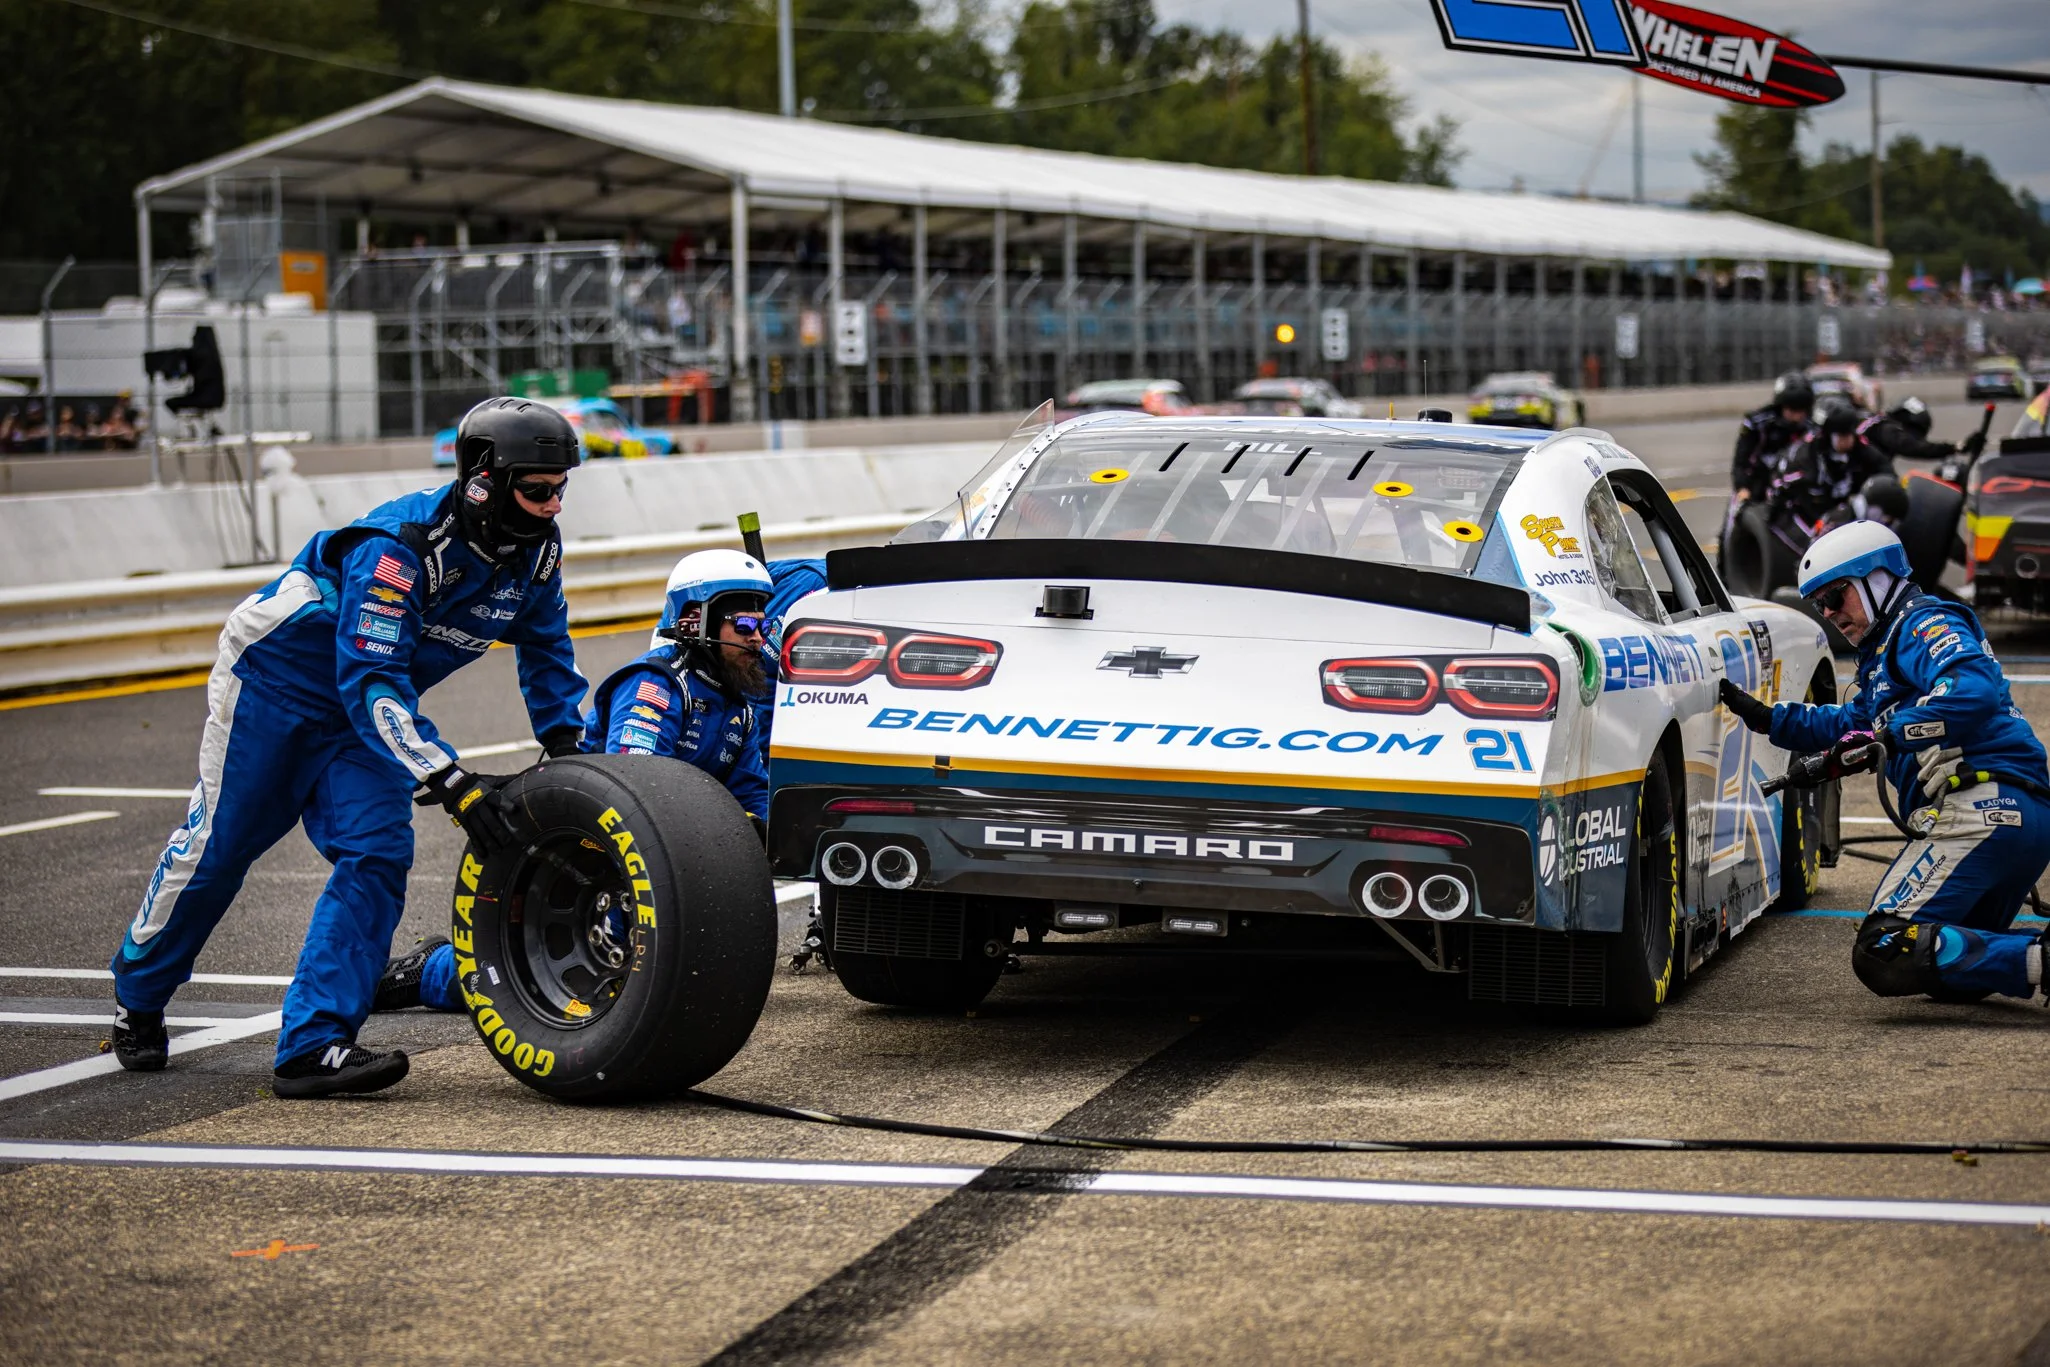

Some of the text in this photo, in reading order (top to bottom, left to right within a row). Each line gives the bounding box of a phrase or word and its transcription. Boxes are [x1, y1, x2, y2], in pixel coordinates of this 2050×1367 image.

[1630, 6, 1779, 84] WHELEN
[1700, 73, 1713, 85] IN
[1713, 79, 1761, 99] AMERICA
[540, 542, 559, 582] sparco
[1535, 569, 1596, 587] John 3:16
[365, 641, 396, 656] SENIX
[1598, 634, 1705, 693] BENNETT
[1931, 635, 1959, 656] COMETIC
[797, 691, 869, 706] OKUMA
[385, 714, 437, 770] BENNETT
[867, 707, 1444, 757] BENNETTIG.COM
[1464, 727, 1537, 774] 21
[1909, 726, 1921, 737] sfi
[1980, 798, 2018, 809] LADYGA
[984, 825, 1294, 862] CAMARO
[597, 806, 657, 929] EAGLE
[1916, 854, 1947, 893] LOGISTICS
[451, 851, 557, 1078] GOODYEAR
[321, 1046, 351, 1069] N
